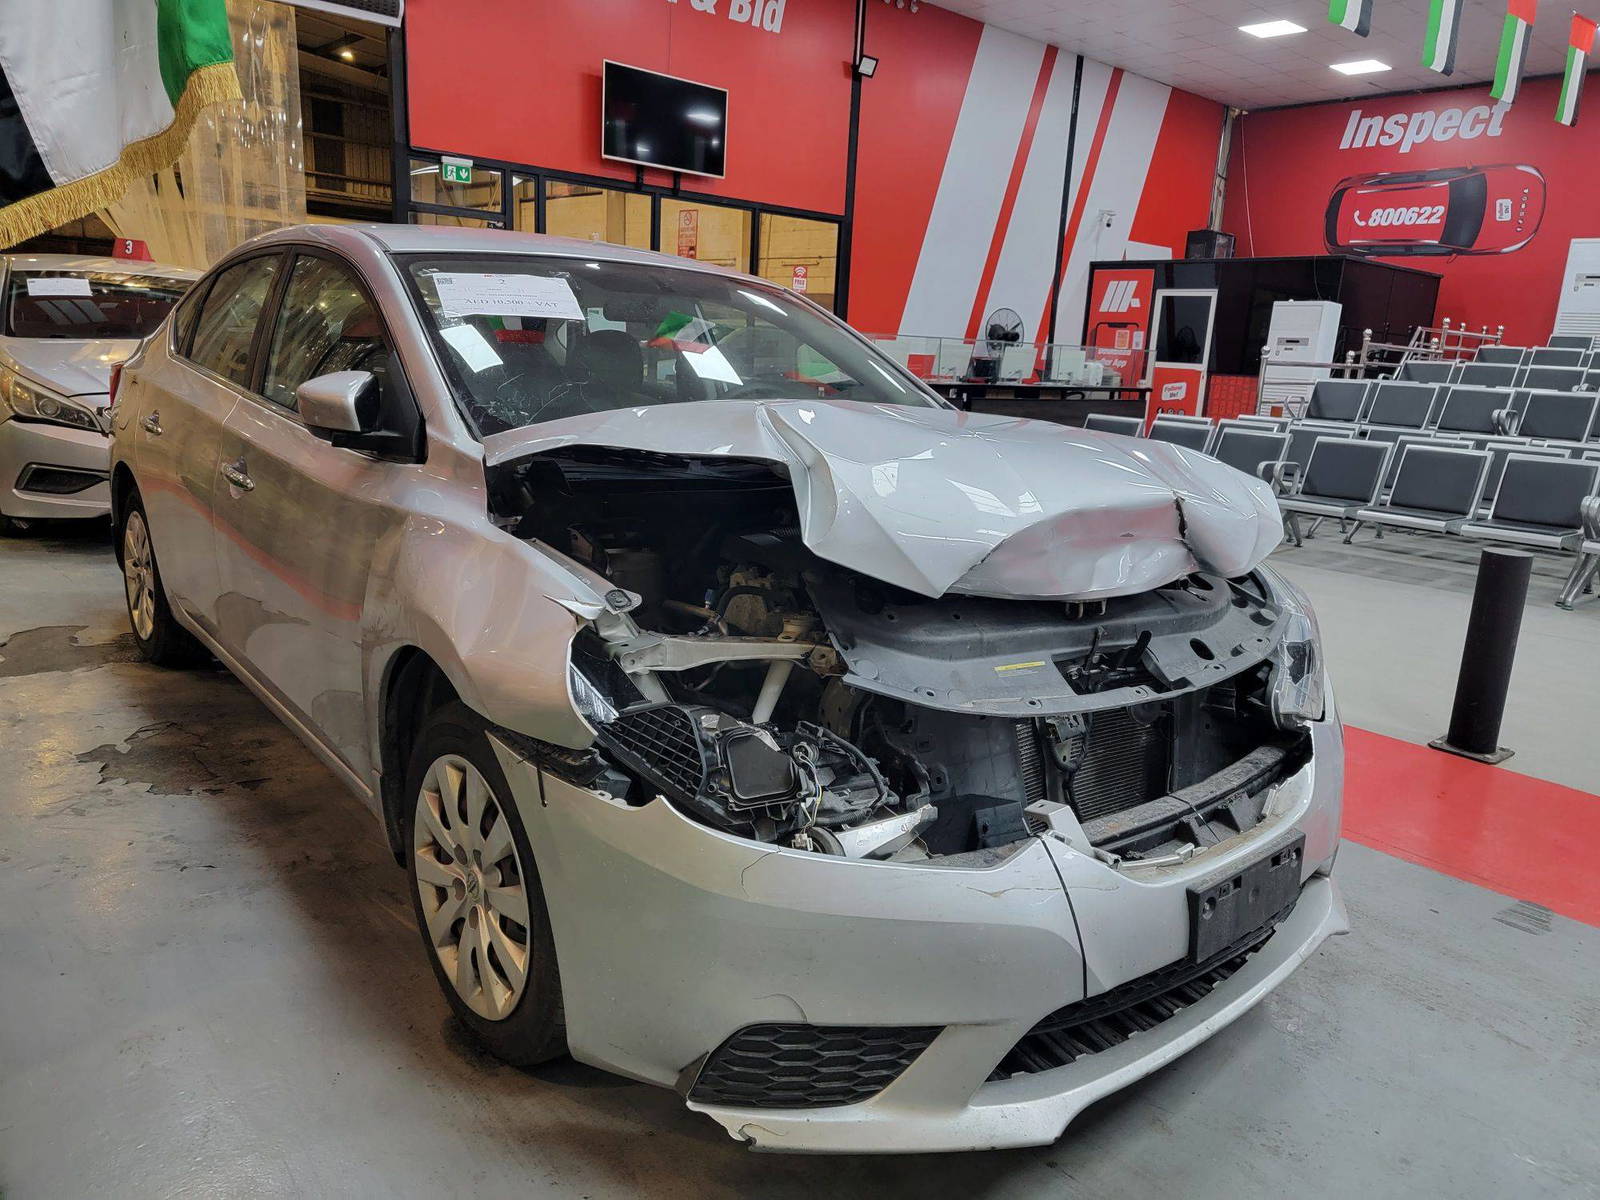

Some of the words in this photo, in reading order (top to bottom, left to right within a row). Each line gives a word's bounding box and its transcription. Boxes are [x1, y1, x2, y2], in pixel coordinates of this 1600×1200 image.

[1339, 103, 1512, 153] Inspect
[1368, 205, 1445, 227] 800622
[125, 240, 133, 254] 3
[1112, 359, 1127, 369] App
